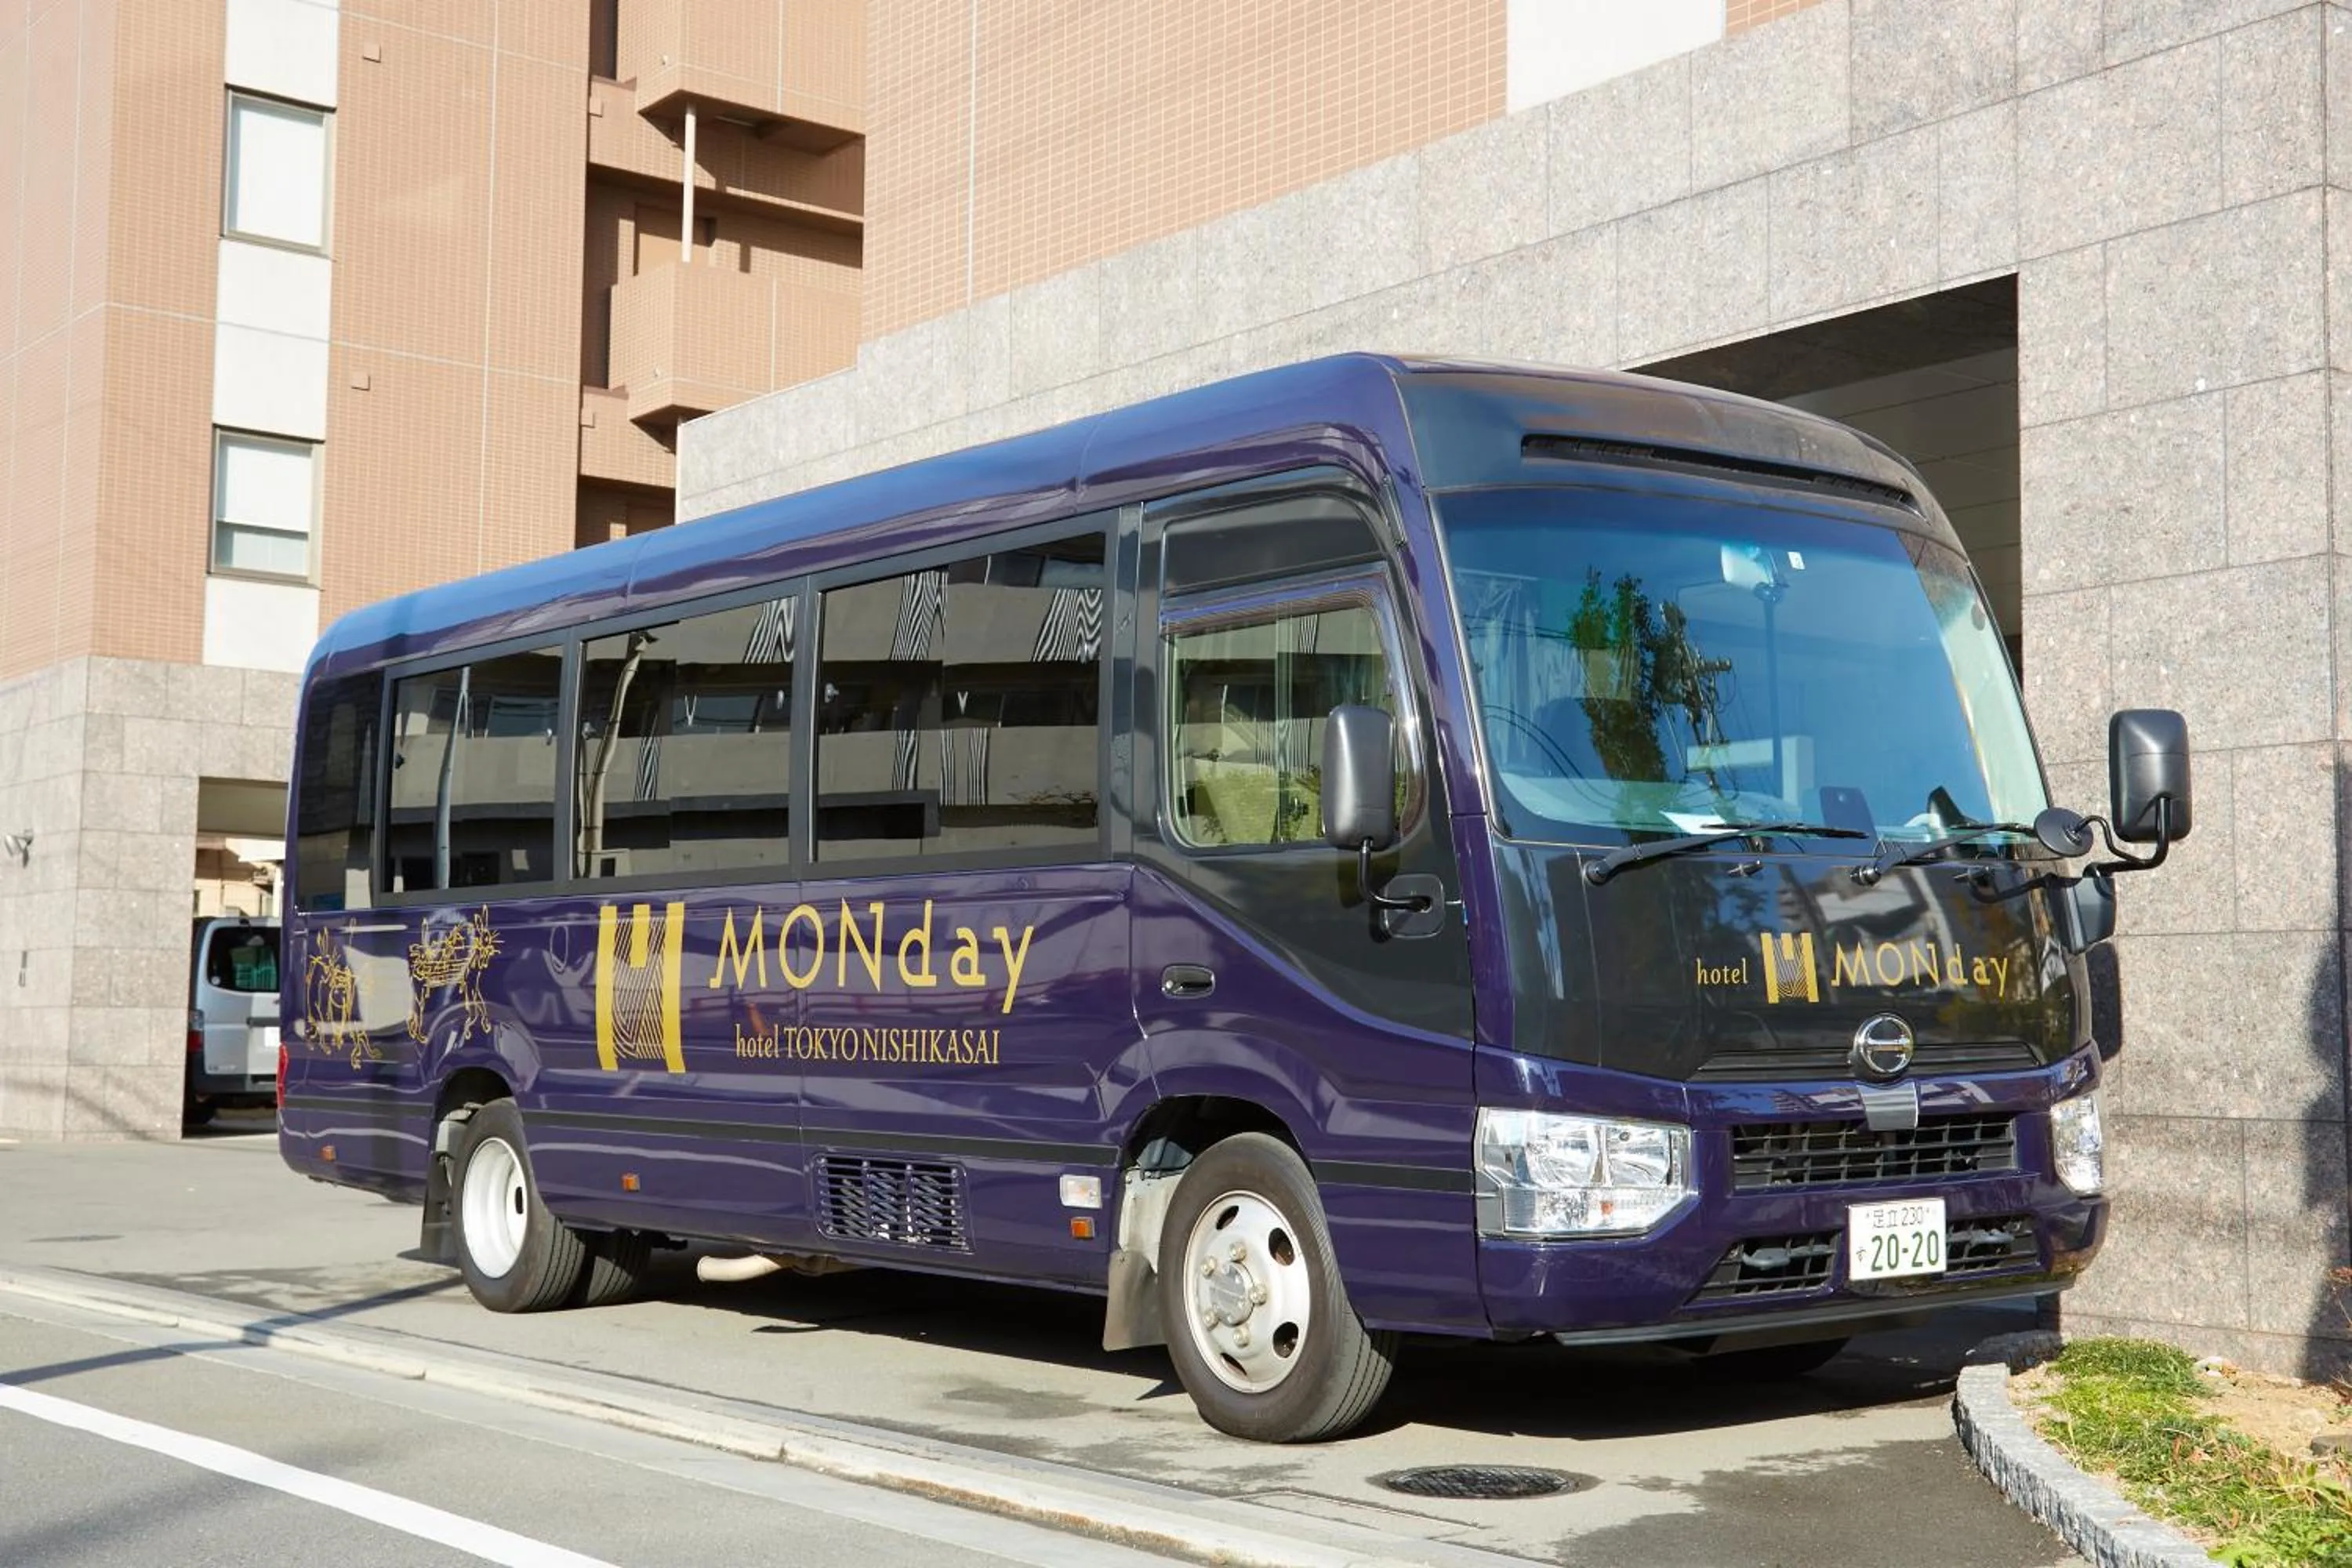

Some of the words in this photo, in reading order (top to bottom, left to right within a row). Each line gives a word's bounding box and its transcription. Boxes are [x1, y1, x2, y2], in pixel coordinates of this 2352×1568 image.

[710, 897, 1034, 1014] MONday
[1696, 957, 1748, 985] hotel
[1831, 941, 2008, 998] MONday
[735, 1023, 779, 1058] hotel
[784, 1025, 858, 1061] TOKYO
[862, 1028, 1000, 1065] NISHIKASAI
[1871, 1229, 1939, 1272] 20-20
